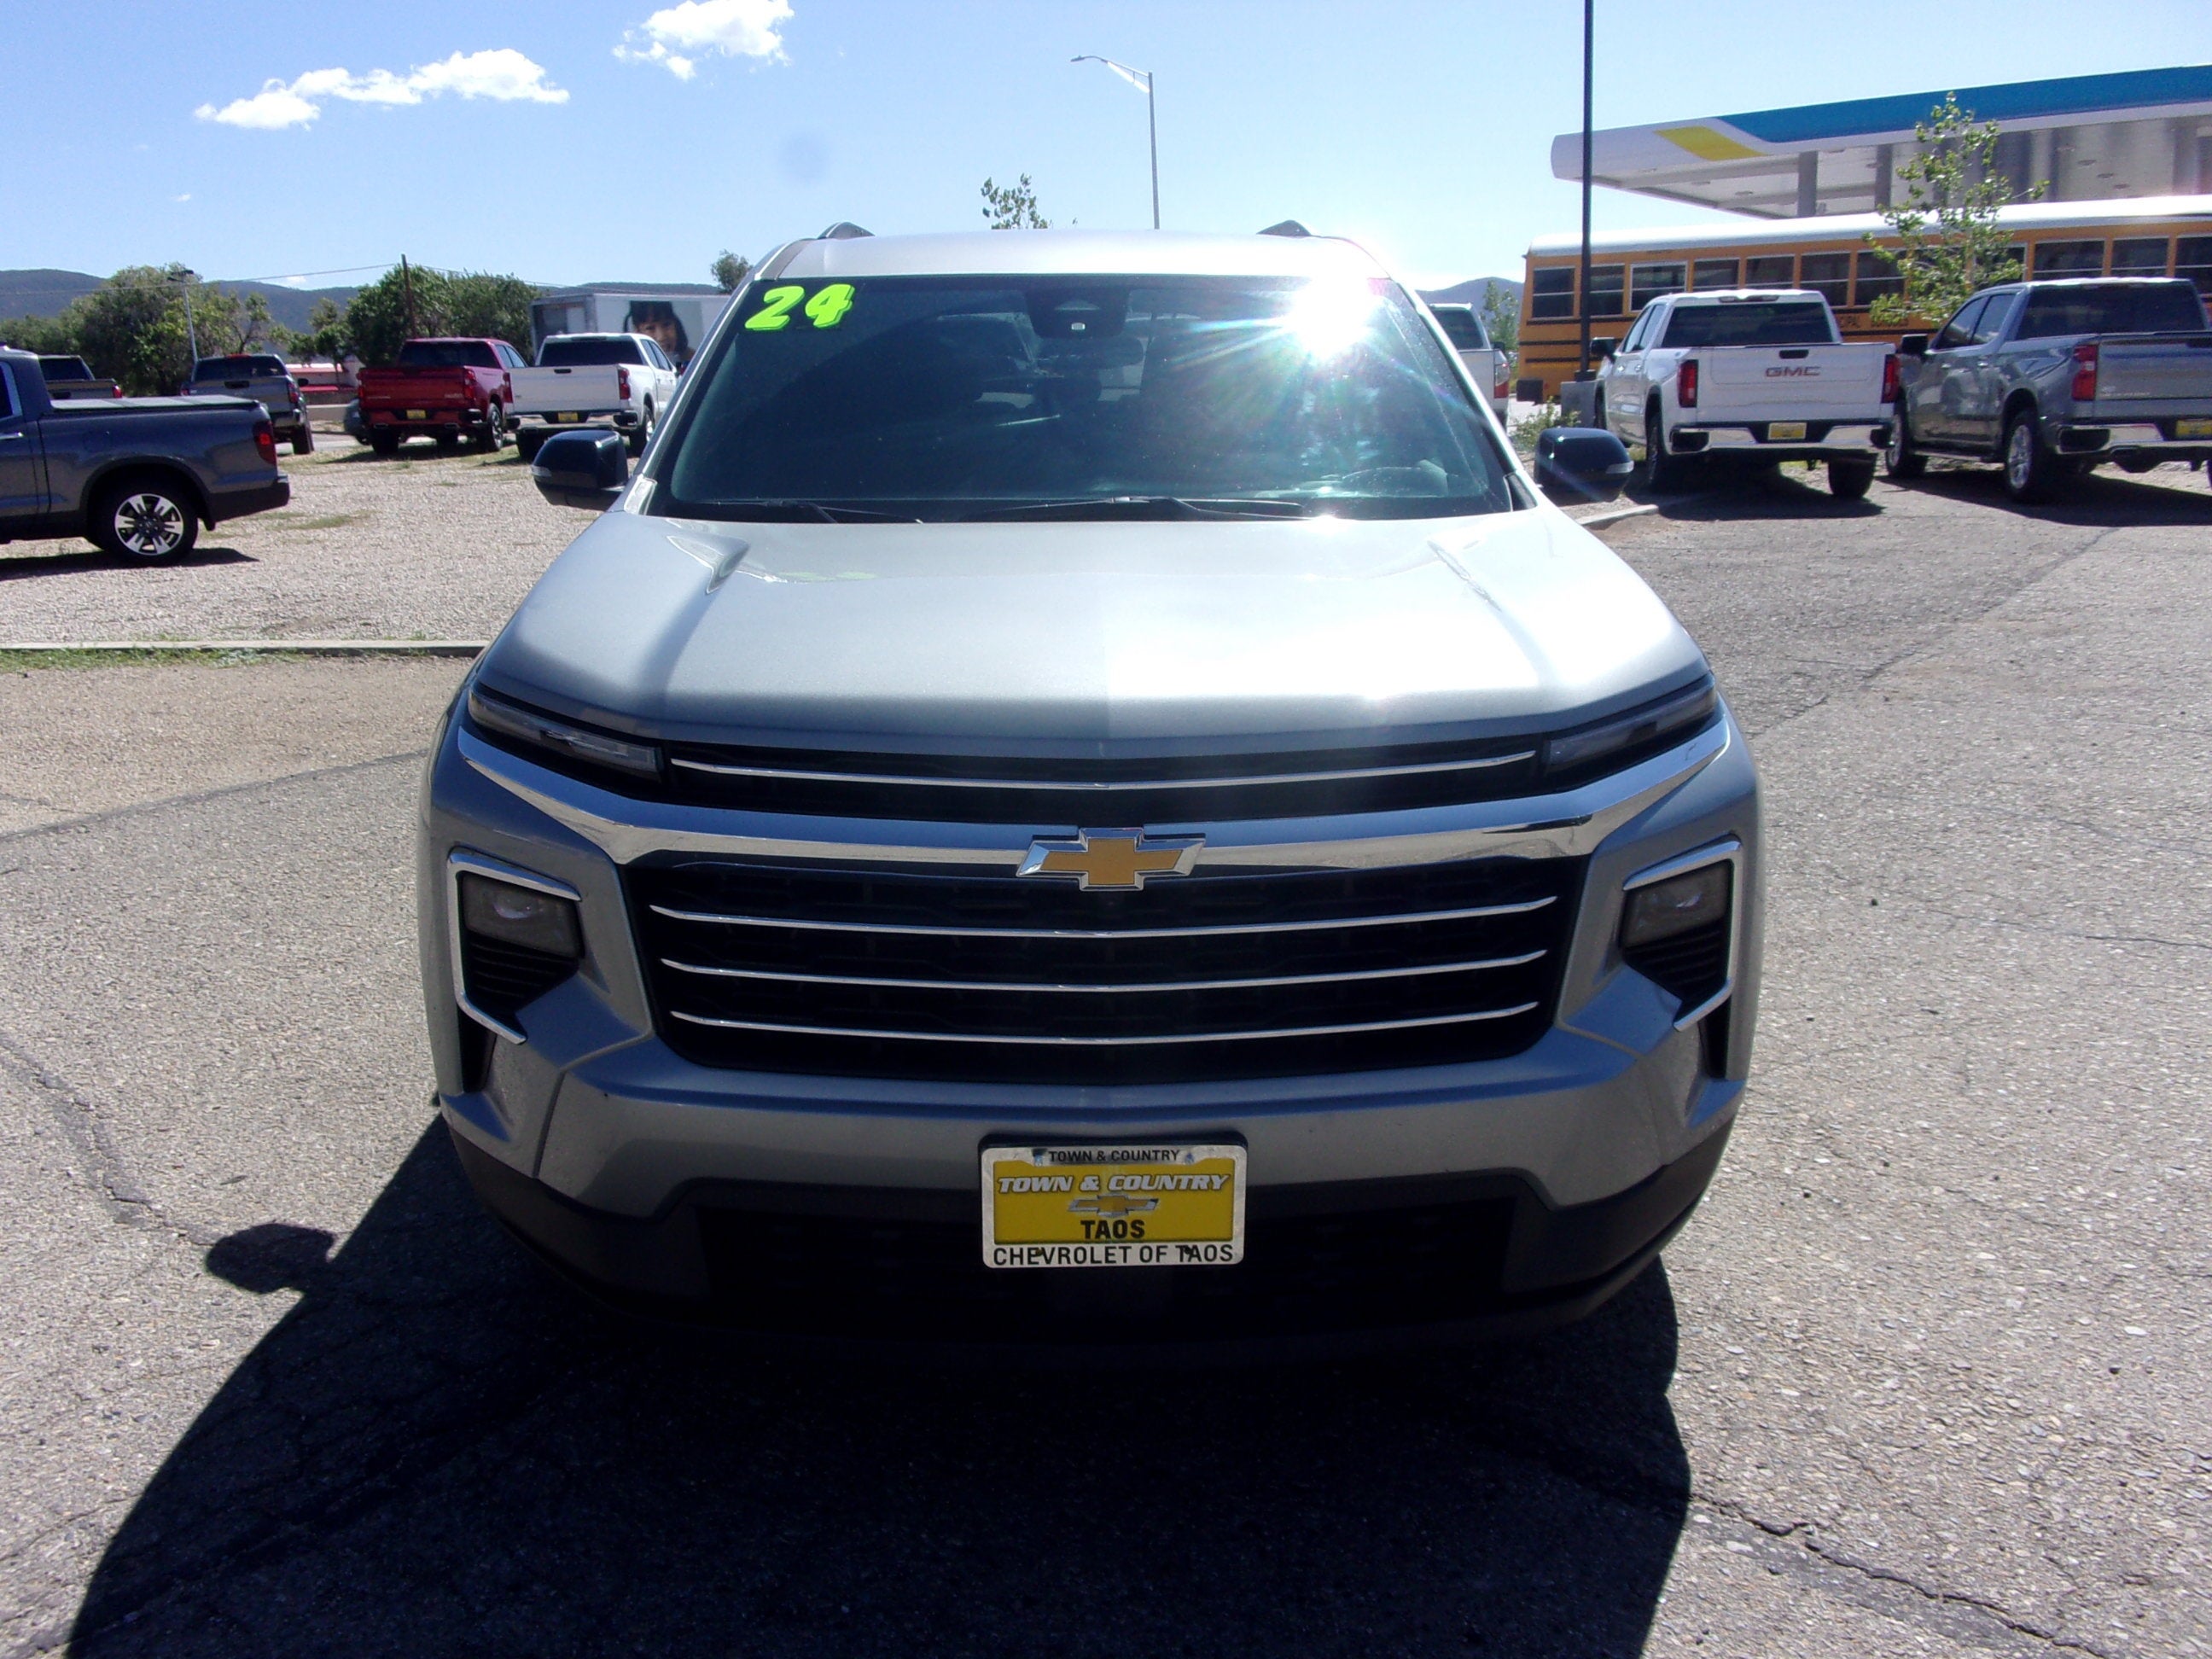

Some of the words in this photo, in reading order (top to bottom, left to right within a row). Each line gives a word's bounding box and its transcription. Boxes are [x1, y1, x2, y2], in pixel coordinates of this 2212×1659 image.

[744, 283, 855, 330] 24
[1765, 366, 1821, 377] GMC
[1050, 1151, 1093, 1161] TOWN
[1096, 1150, 1106, 1161] &
[1111, 1150, 1179, 1161] COUNTRY
[998, 1176, 1073, 1193] TOWN
[1079, 1175, 1101, 1192] &
[1108, 1173, 1231, 1192] COUNTRY
[1081, 1220, 1144, 1239] TAOS
[993, 1245, 1132, 1266] CHEVROLET
[1139, 1245, 1167, 1263] OF
[1175, 1244, 1234, 1262] TAOS
